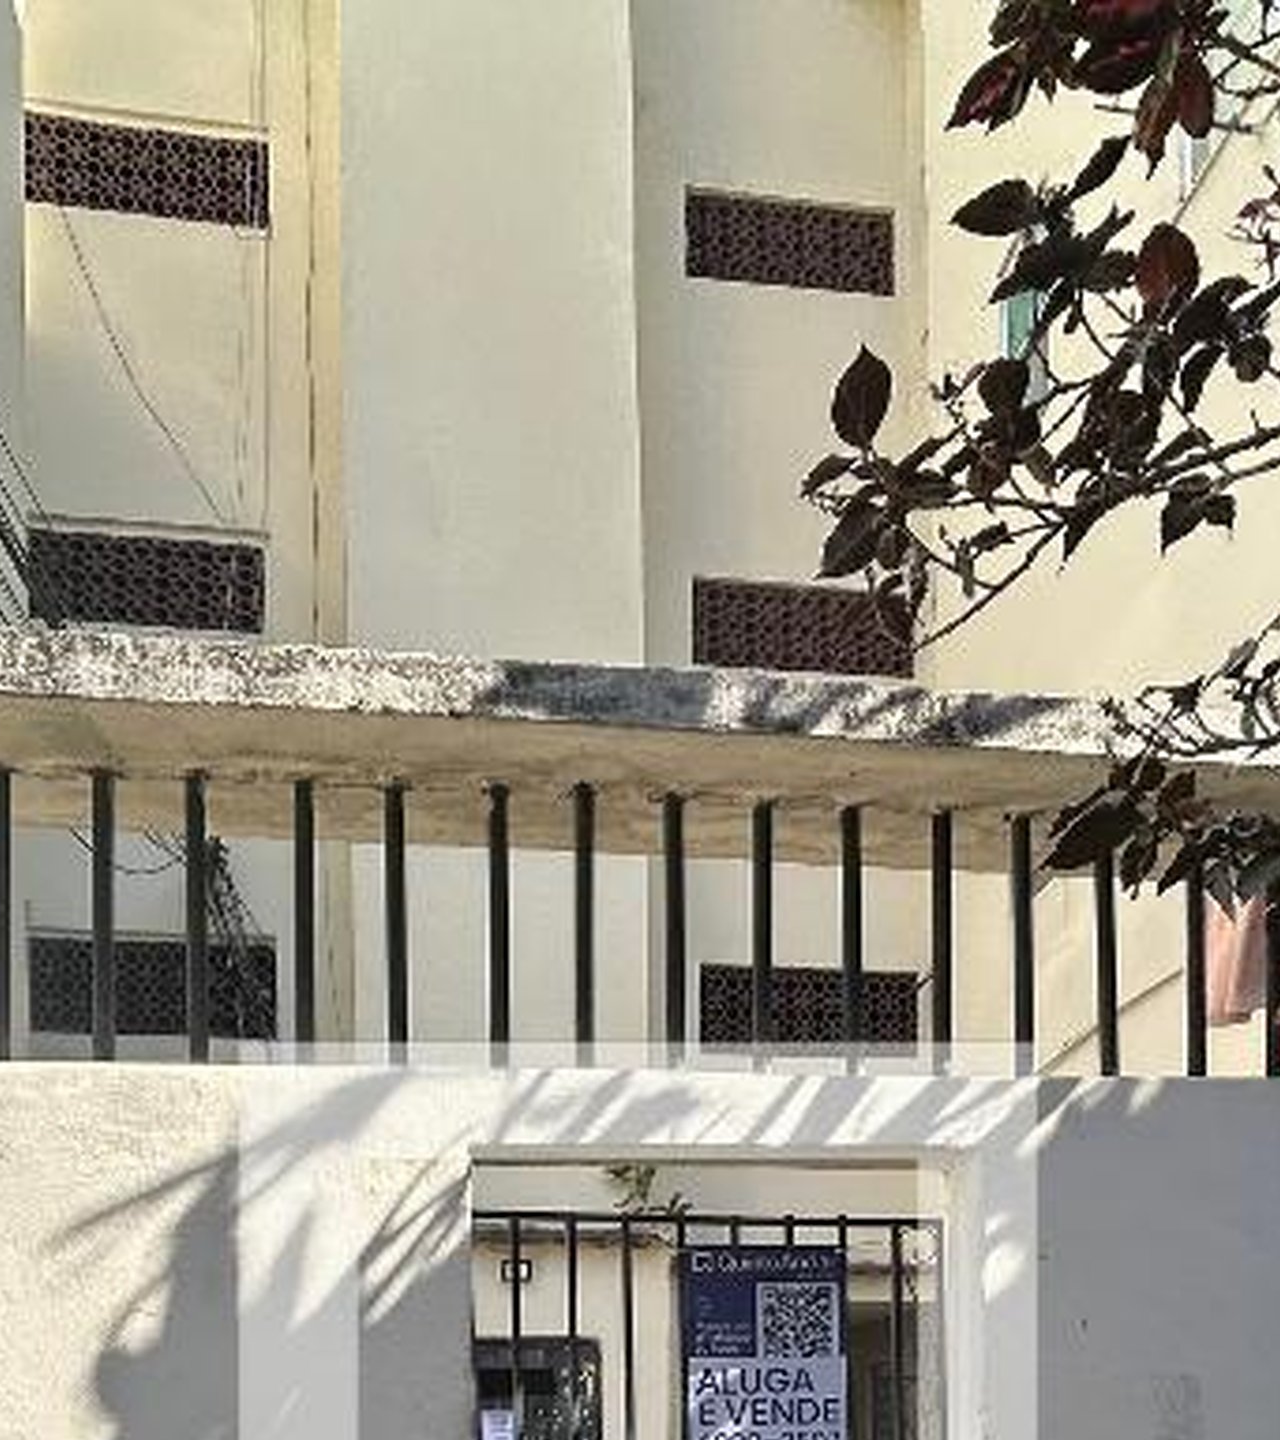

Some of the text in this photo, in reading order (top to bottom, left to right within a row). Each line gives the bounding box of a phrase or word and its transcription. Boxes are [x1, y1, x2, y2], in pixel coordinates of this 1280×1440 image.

[695, 1367, 815, 1396] ALUGA
[698, 1397, 840, 1426] E VENDE
